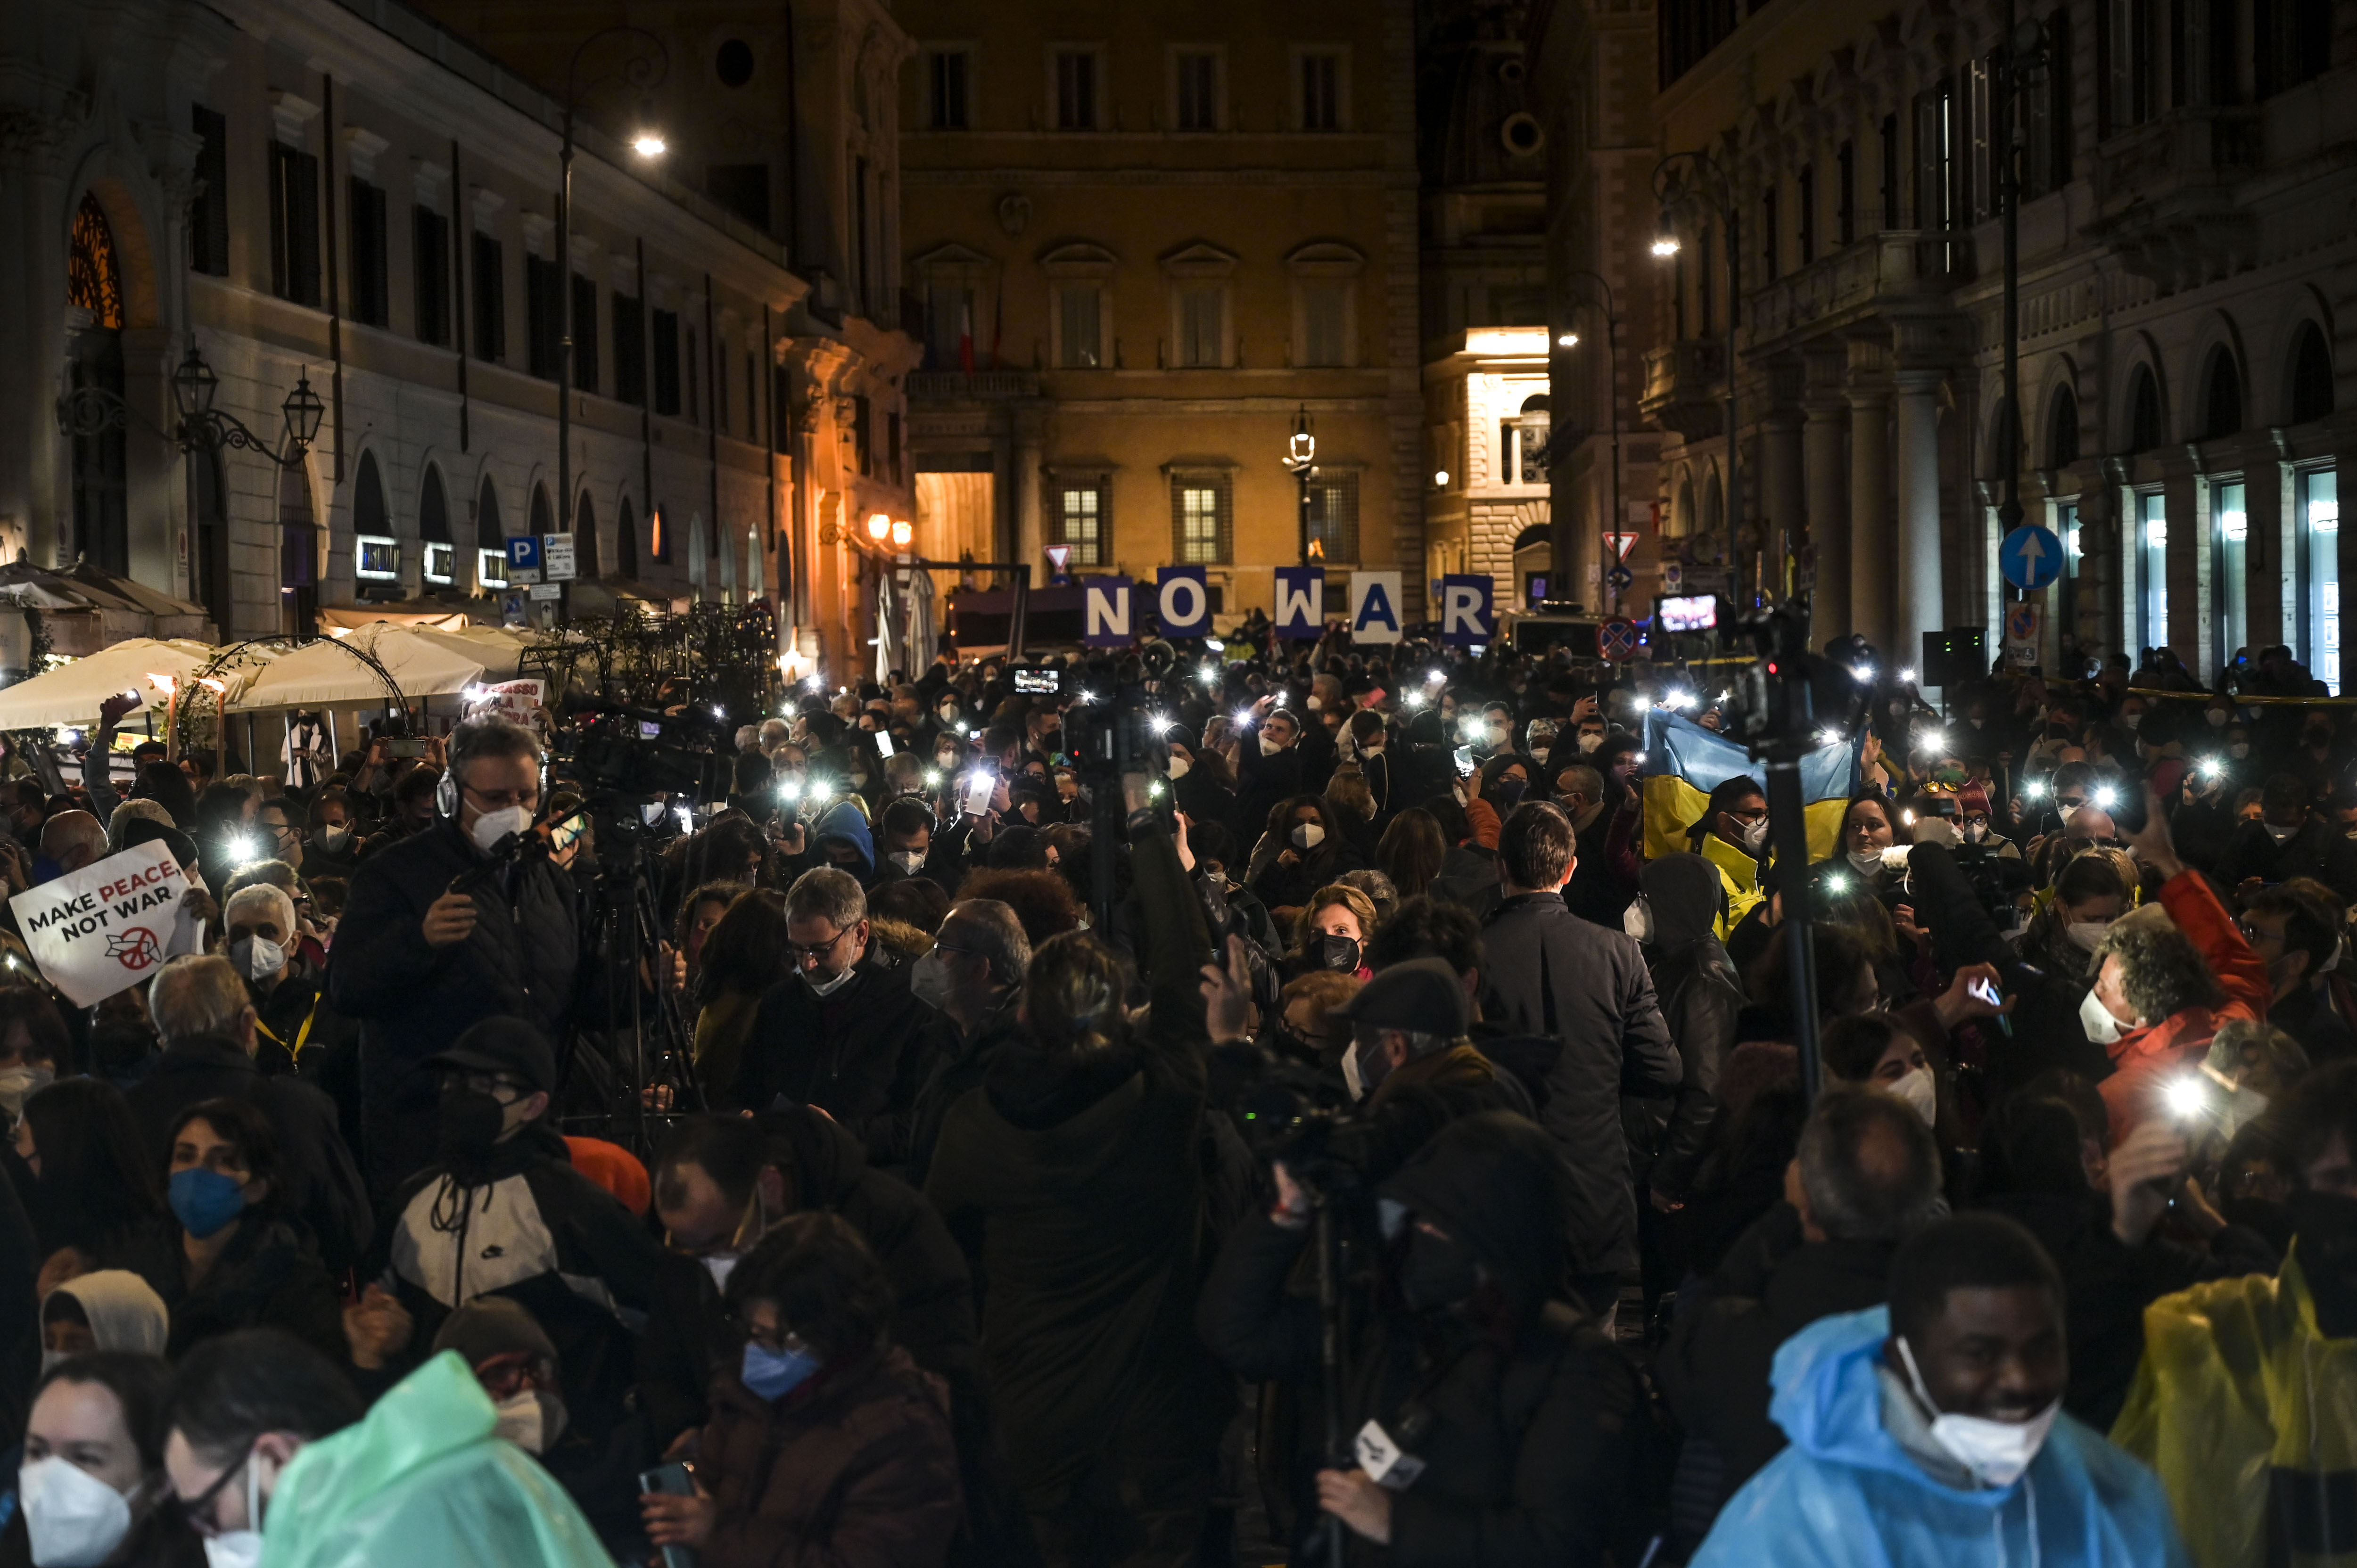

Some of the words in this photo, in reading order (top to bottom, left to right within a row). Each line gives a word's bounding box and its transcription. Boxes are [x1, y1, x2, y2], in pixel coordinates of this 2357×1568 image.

[514, 542, 531, 563] P
[1087, 577, 1206, 635] NO
[1276, 578, 1487, 634] WAR
[28, 893, 96, 932] MAKE
[99, 860, 181, 903] PEACE,
[61, 910, 108, 942] NOT
[114, 886, 172, 919] WAR
